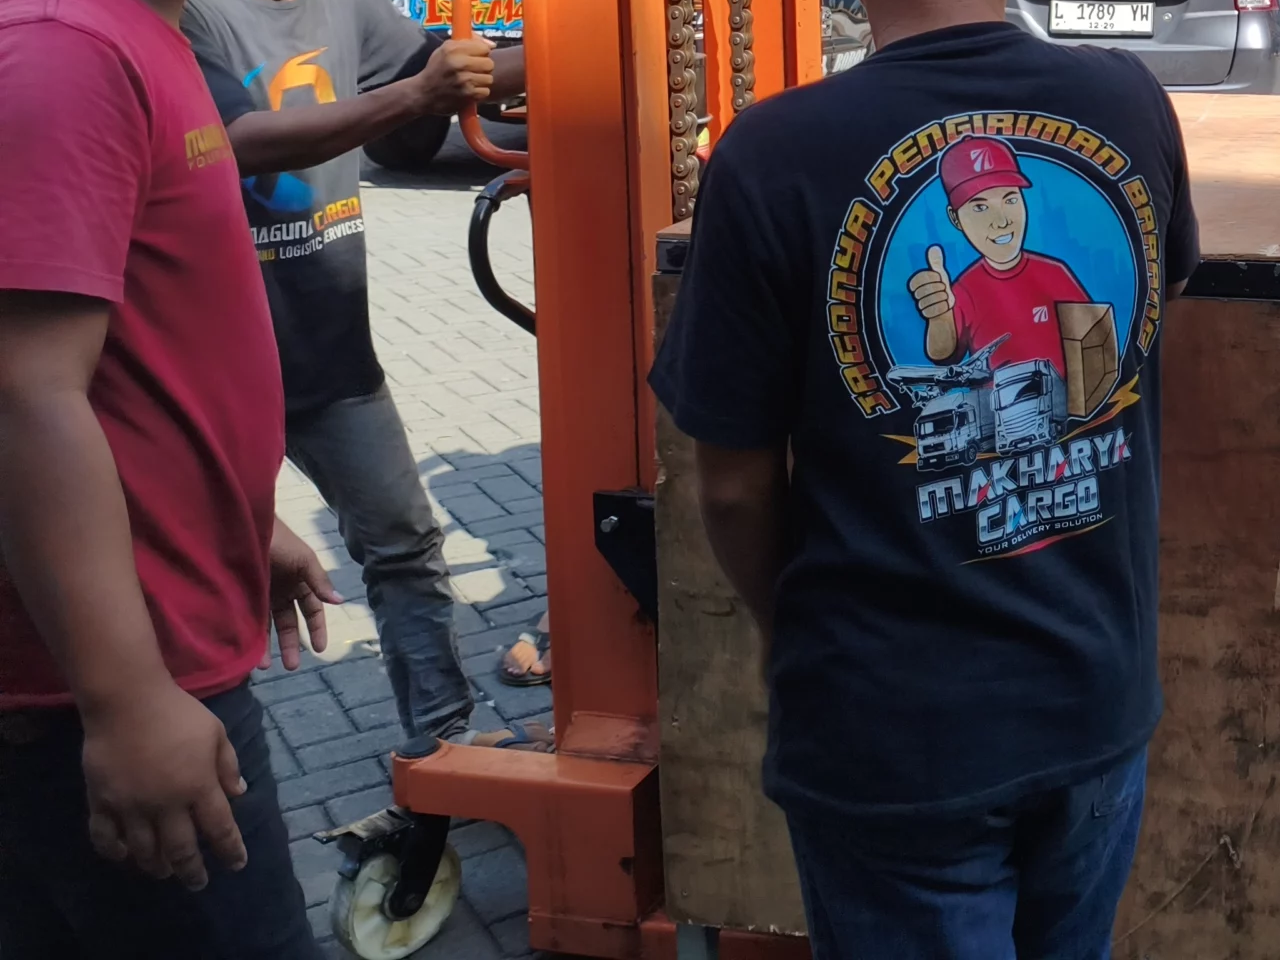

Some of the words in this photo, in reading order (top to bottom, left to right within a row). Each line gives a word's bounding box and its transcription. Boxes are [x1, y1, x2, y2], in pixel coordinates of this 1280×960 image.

[1054, 2, 1064, 19] L
[1076, 3, 1116, 21] 1789
[1131, 4, 1149, 22] YW
[322, 218, 365, 245] ERVICES
[828, 199, 895, 416] JAGONYA
[867, 111, 1131, 201] PENGIRIMAN
[1120, 177, 1161, 354] BARANG
[917, 426, 1132, 522] MAKHARYA
[977, 478, 1099, 544] CARGO
[978, 541, 1009, 555] YOUR
[1011, 524, 1051, 545] DELIVERY
[1054, 513, 1103, 529] SOLUTION
